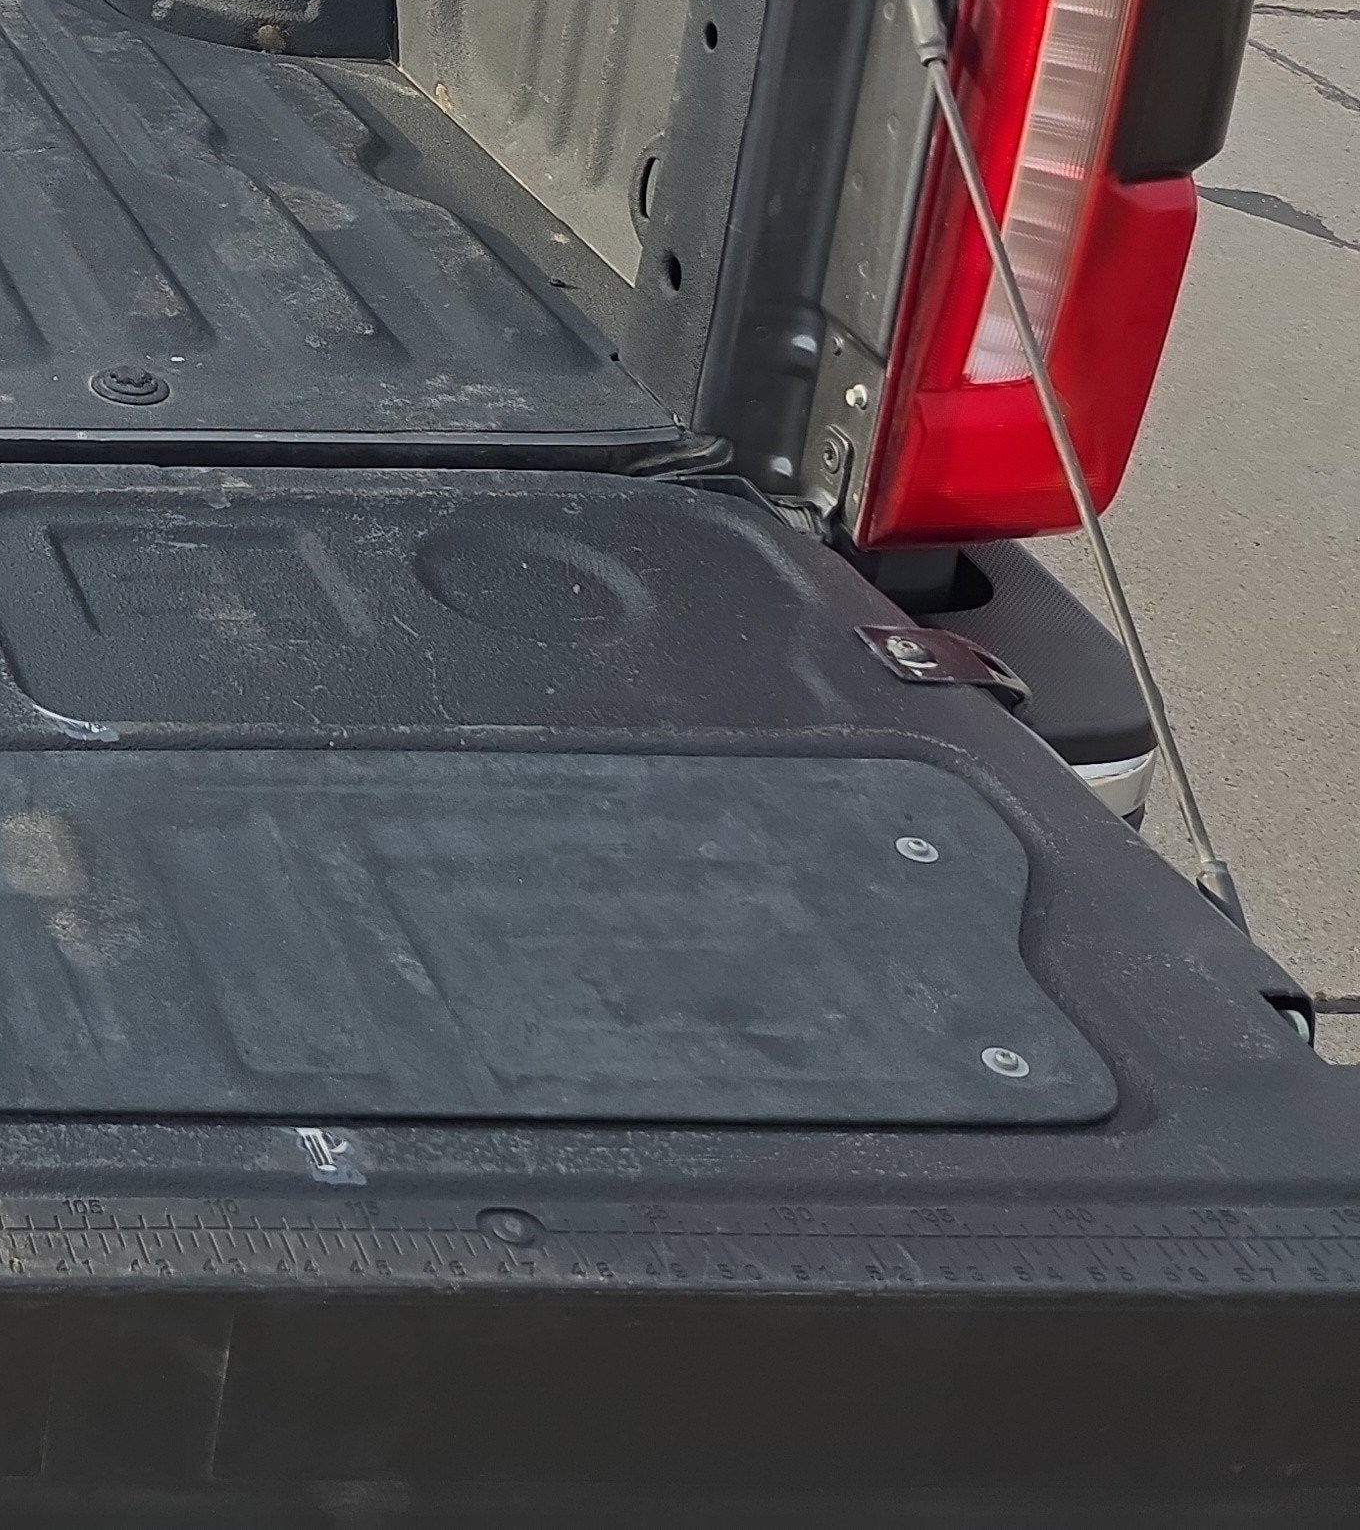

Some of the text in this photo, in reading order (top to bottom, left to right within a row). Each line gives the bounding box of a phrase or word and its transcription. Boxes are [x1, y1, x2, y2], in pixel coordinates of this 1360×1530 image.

[63, 1199, 103, 1215] 105
[55, 1258, 93, 1275] 41
[203, 1258, 246, 1276] 43
[278, 1259, 319, 1276] 44
[424, 1260, 466, 1276] 46
[497, 1261, 536, 1276] 47
[717, 1263, 763, 1279] 50
